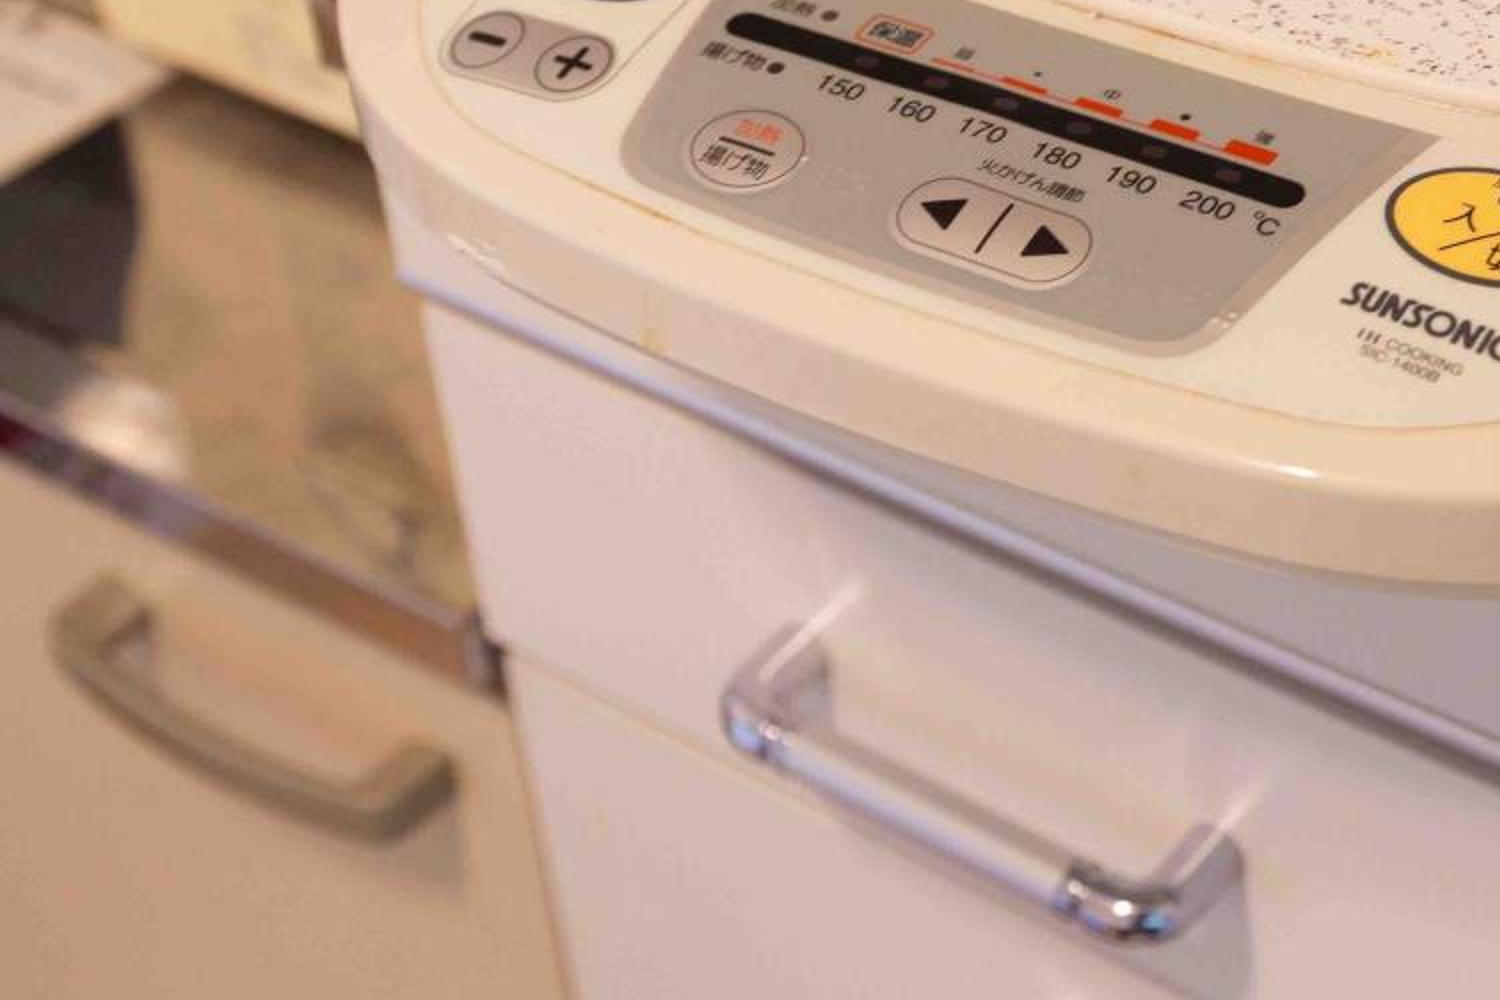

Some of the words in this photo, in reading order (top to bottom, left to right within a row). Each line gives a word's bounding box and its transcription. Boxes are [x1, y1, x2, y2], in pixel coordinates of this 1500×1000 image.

[817, 74, 866, 101] 150
[888, 96, 937, 123] 160
[958, 117, 1008, 143] 170
[1032, 141, 1082, 170] 180
[1106, 165, 1157, 194] 190
[1179, 189, 1236, 220] 200
